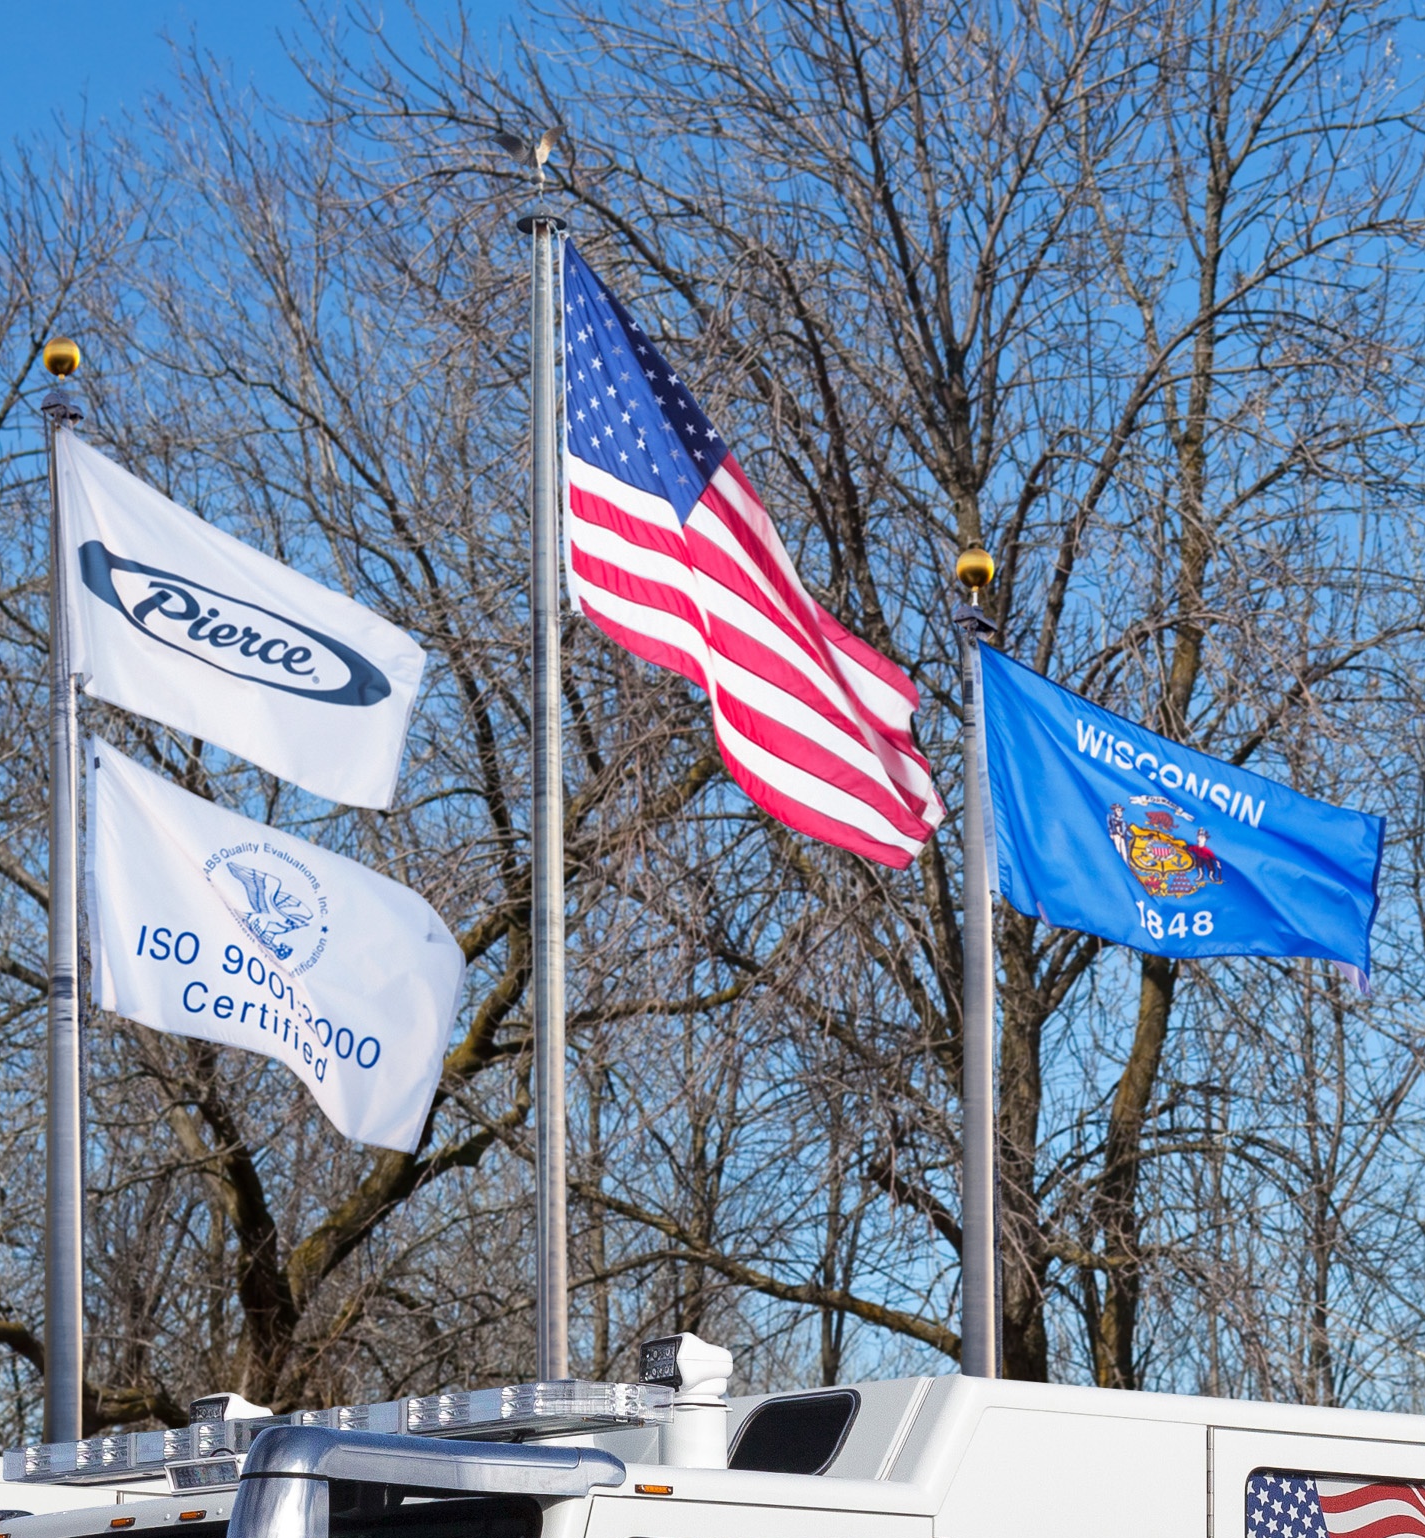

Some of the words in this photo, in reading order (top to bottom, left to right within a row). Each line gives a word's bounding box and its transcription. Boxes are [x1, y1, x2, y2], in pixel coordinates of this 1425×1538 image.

[132, 580, 315, 676] Pierce
[1076, 719, 1266, 829] WISCONSIN
[220, 842, 259, 860] Quality
[1136, 900, 1214, 940] 1848
[136, 925, 200, 966] ISO
[222, 944, 381, 1070] 9001:2000
[183, 981, 327, 1084] Certified
